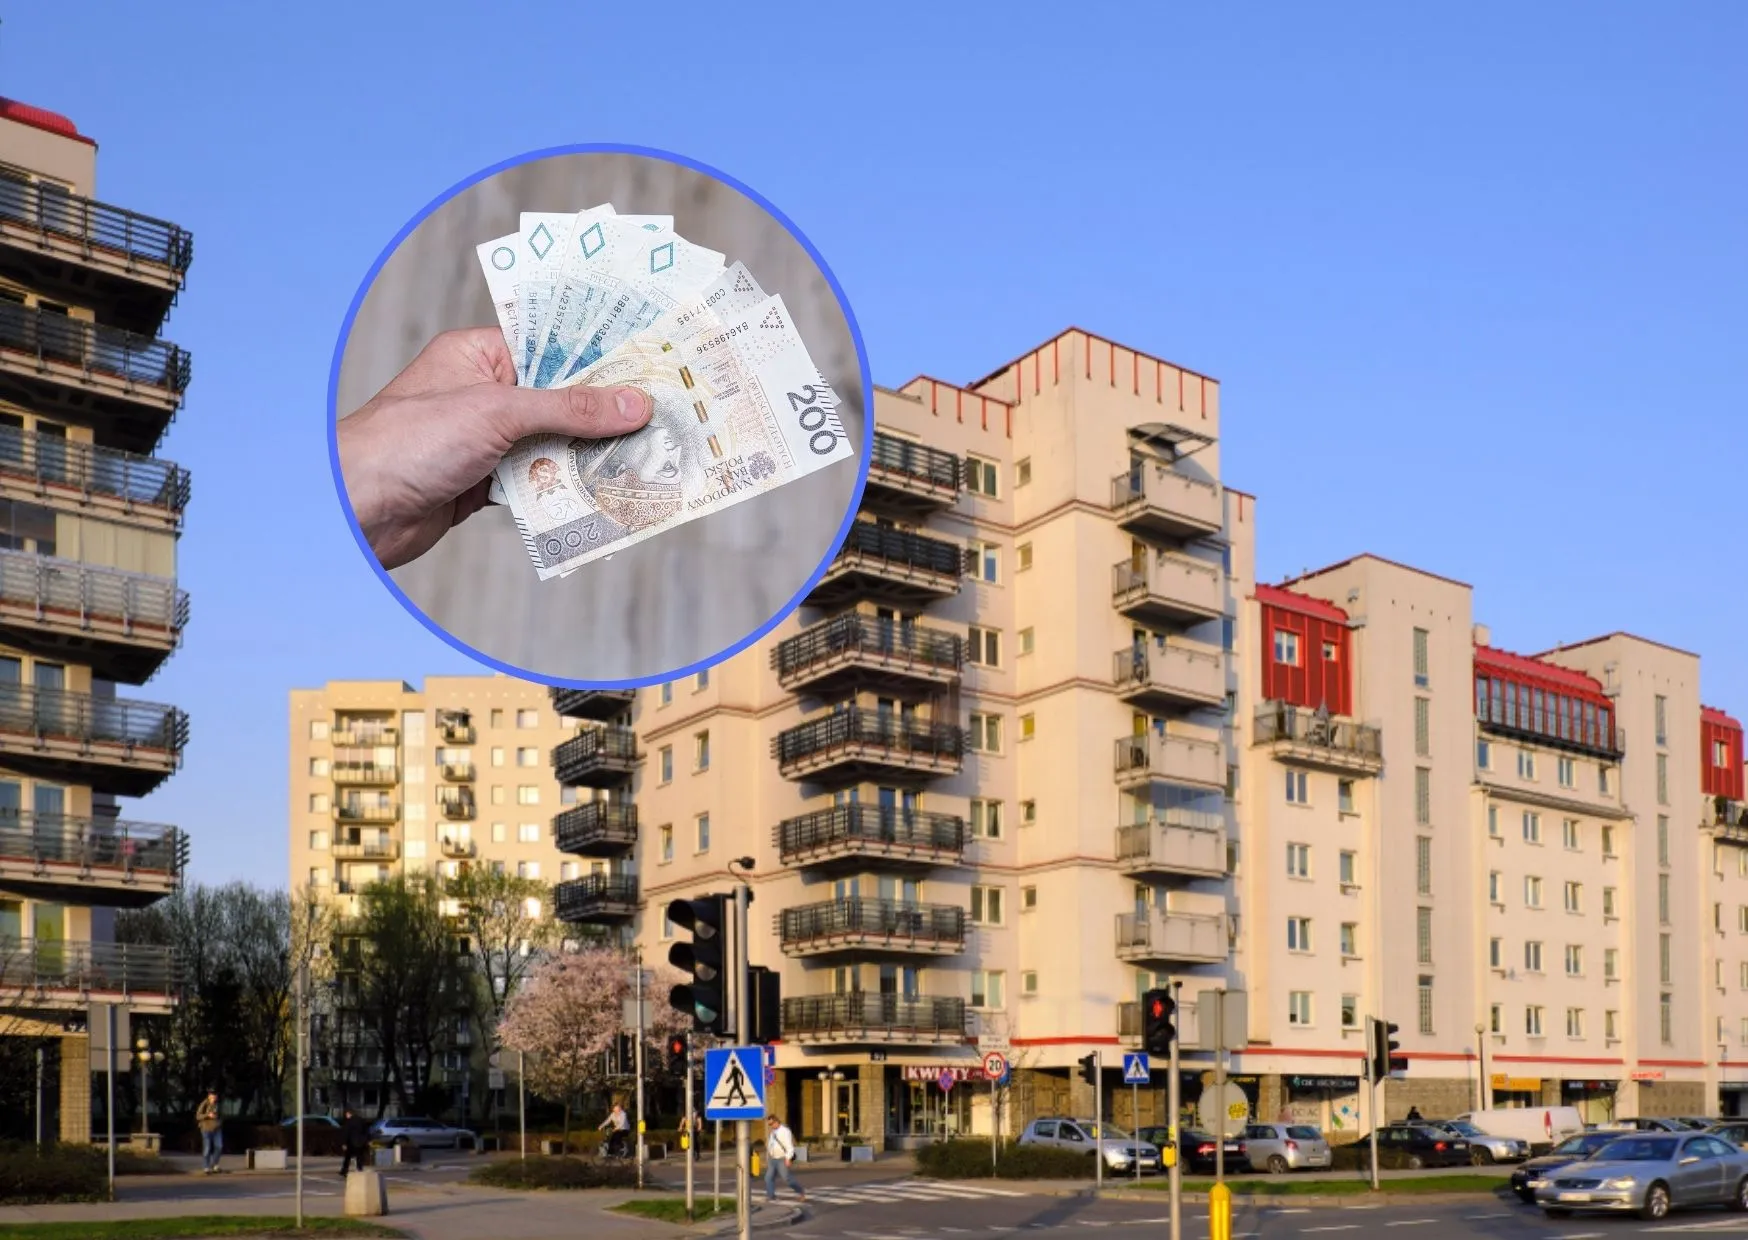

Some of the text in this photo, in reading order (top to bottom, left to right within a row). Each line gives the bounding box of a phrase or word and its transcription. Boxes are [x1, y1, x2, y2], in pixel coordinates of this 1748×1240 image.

[547, 284, 572, 344] AJ2357530
[695, 321, 748, 354] BA6498536
[786, 384, 838, 455] 200
[703, 454, 743, 477] POLSKI
[715, 466, 748, 485] BANK
[687, 477, 753, 510] NARODOWY
[545, 521, 599, 556] 200
[989, 1060, 1001, 1072] 20
